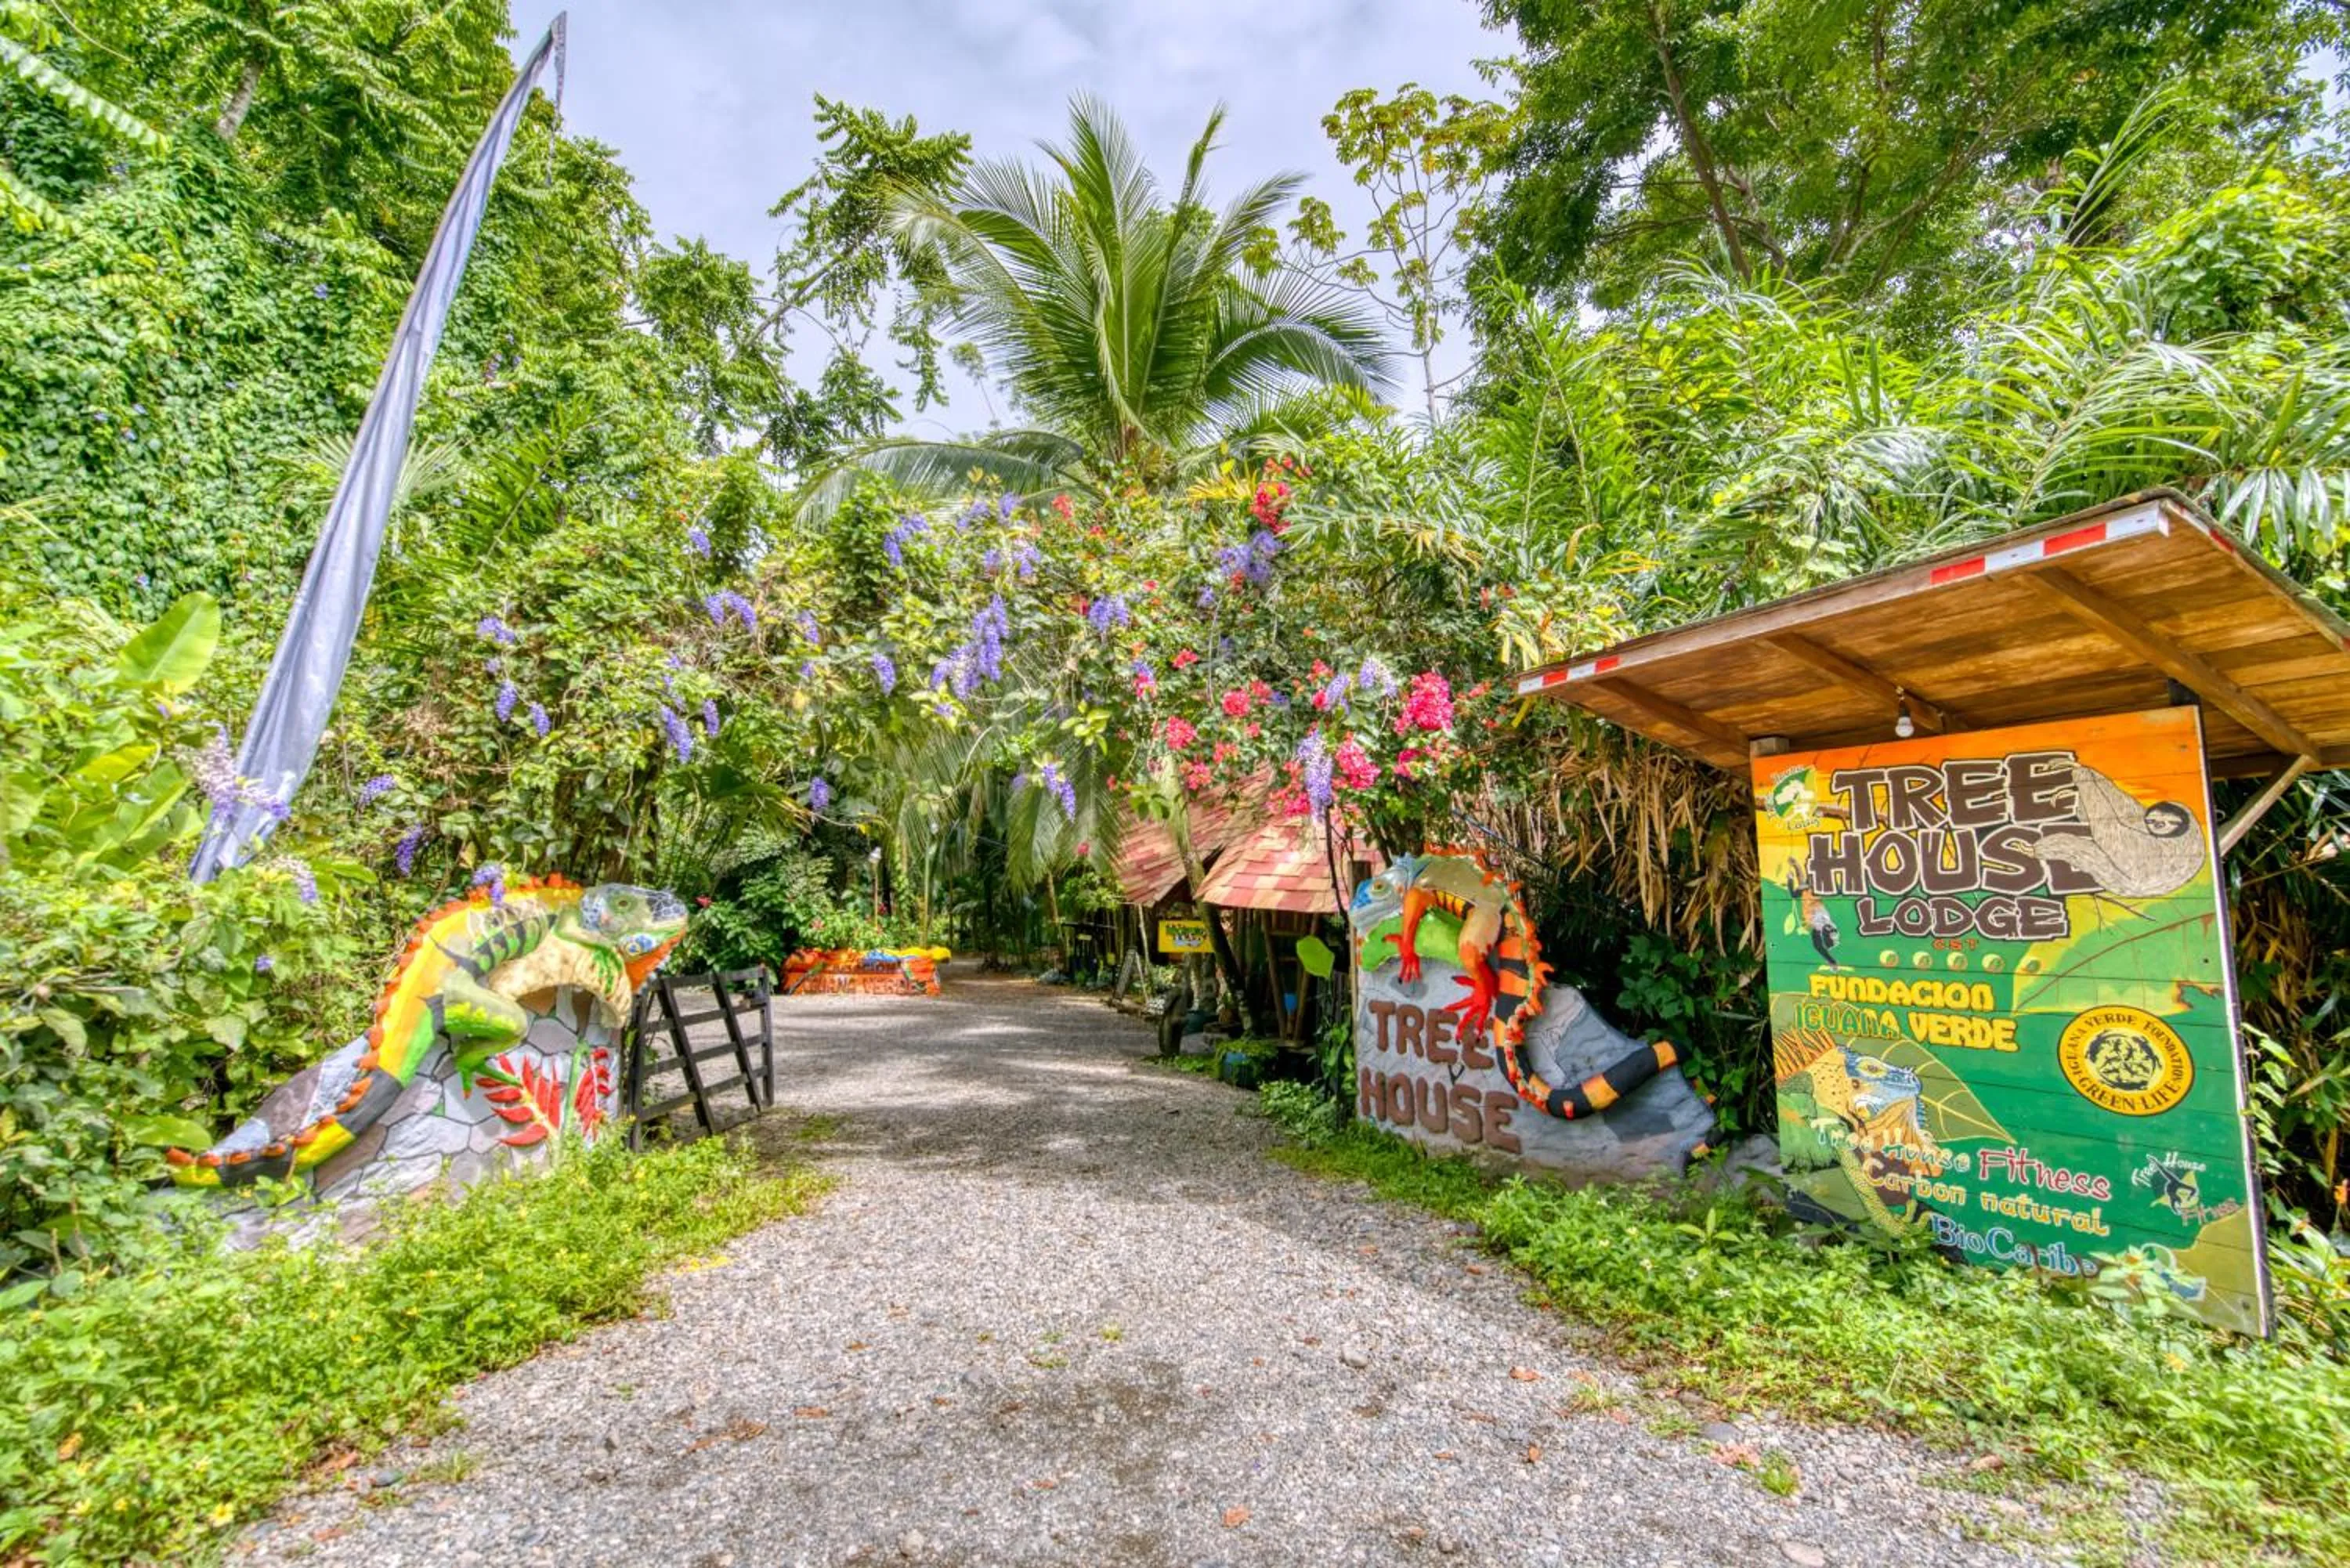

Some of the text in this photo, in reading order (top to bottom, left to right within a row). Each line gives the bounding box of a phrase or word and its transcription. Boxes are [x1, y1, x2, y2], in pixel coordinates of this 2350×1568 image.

[1830, 750, 2078, 831] TREE
[1807, 821, 2106, 897] HOUSE
[1855, 893, 2070, 941] LODGE
[1808, 974, 1995, 1012] FUNDACION
[2084, 1013, 2138, 1028] VERDE
[1368, 1000, 1495, 1070] TREE
[1794, 1002, 2020, 1052] IGUANA VERDE
[1360, 1066, 1521, 1154] HOUSE
[2078, 1077, 2182, 1111] GREEN LIFE
[1810, 1117, 1875, 1151] Tree
[1978, 1146, 2113, 1200] Fitness
[2163, 1151, 2207, 1172] House
[1862, 1156, 2110, 1237] Carbon natural
